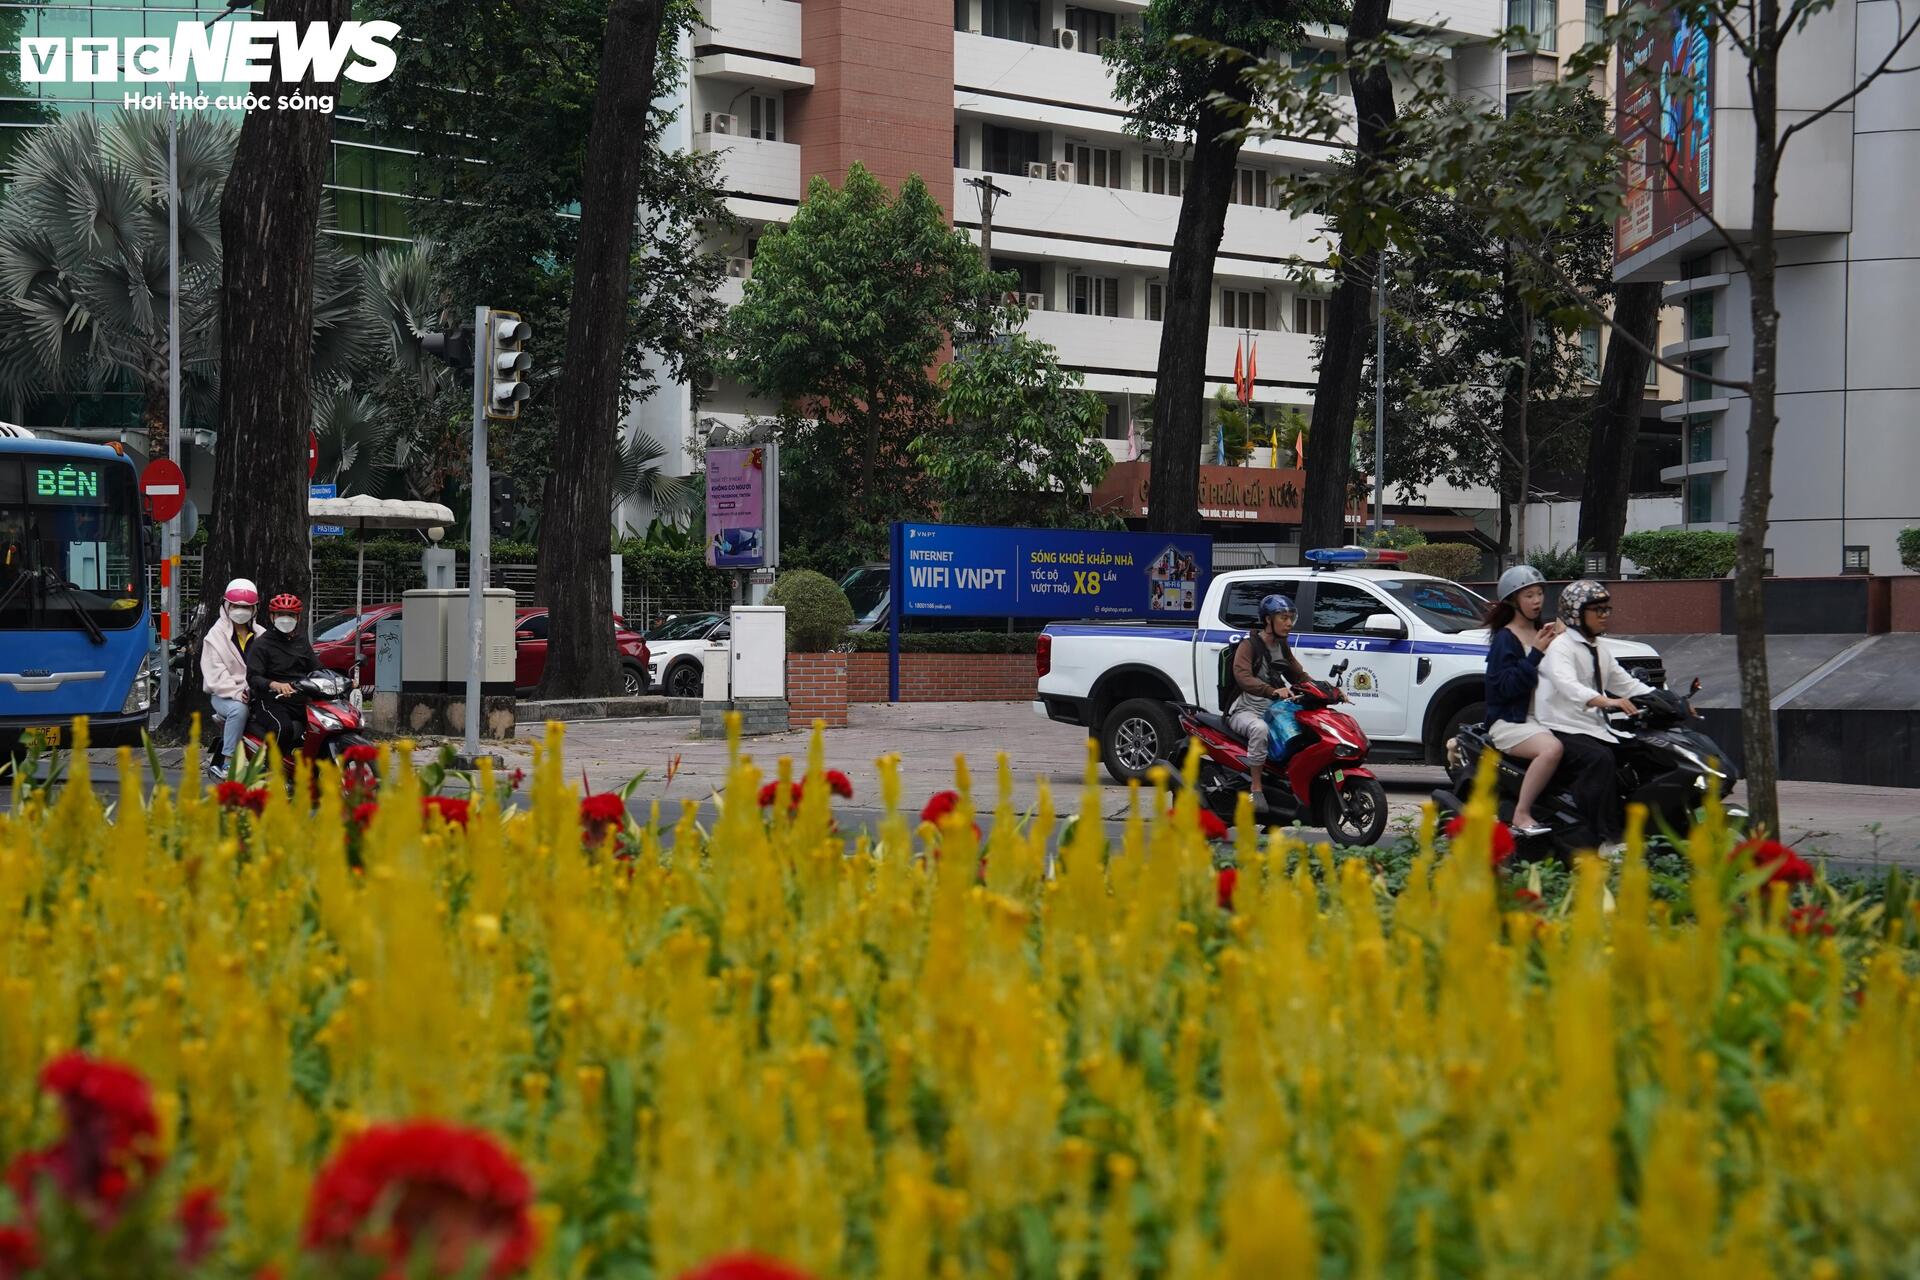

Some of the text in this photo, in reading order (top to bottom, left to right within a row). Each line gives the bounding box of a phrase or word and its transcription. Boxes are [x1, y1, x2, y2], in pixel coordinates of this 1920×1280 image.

[317, 525, 340, 533] PASTEUR
[910, 548, 1134, 566] INTERNET SÓNG KHOẺ KHẮP NHÀ
[910, 566, 1006, 590] WIFI VNPT
[1031, 567, 1046, 580] TỐC
[1047, 569, 1059, 582] ĐỘ
[1073, 571, 1101, 595] X8
[1031, 582, 1070, 595] VƯỢT TRỘI
[1334, 638, 1371, 651] SÁT
